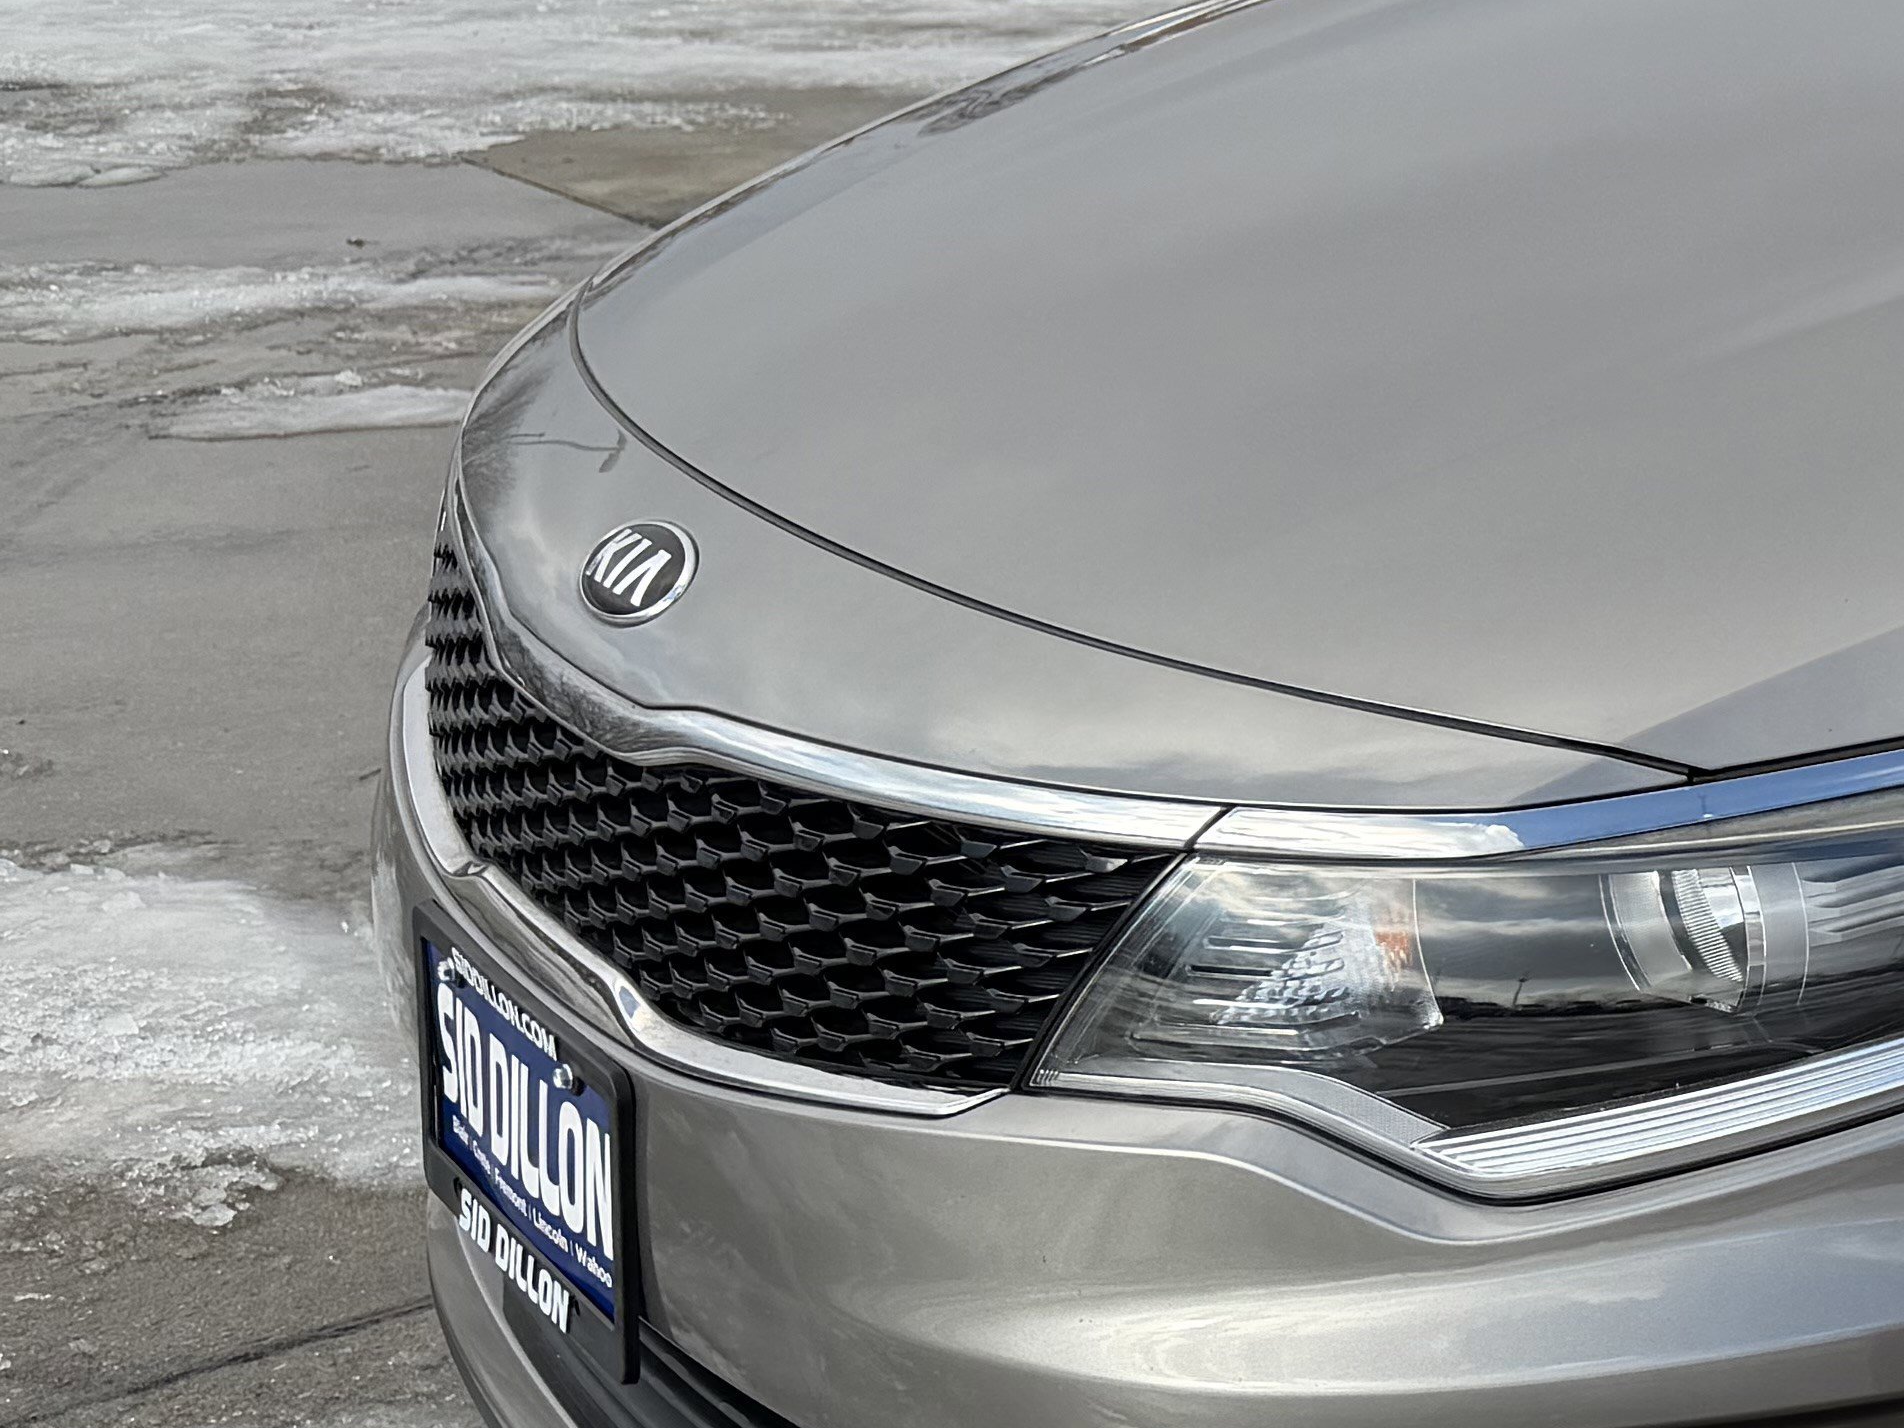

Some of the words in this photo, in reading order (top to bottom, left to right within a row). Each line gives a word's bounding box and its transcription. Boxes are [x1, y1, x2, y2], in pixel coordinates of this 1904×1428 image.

[585, 527, 673, 607] KIA
[437, 982, 483, 1138] SID
[488, 1032, 614, 1262] DILLON
[458, 1187, 491, 1254] SID
[495, 1222, 570, 1334] DILLON
